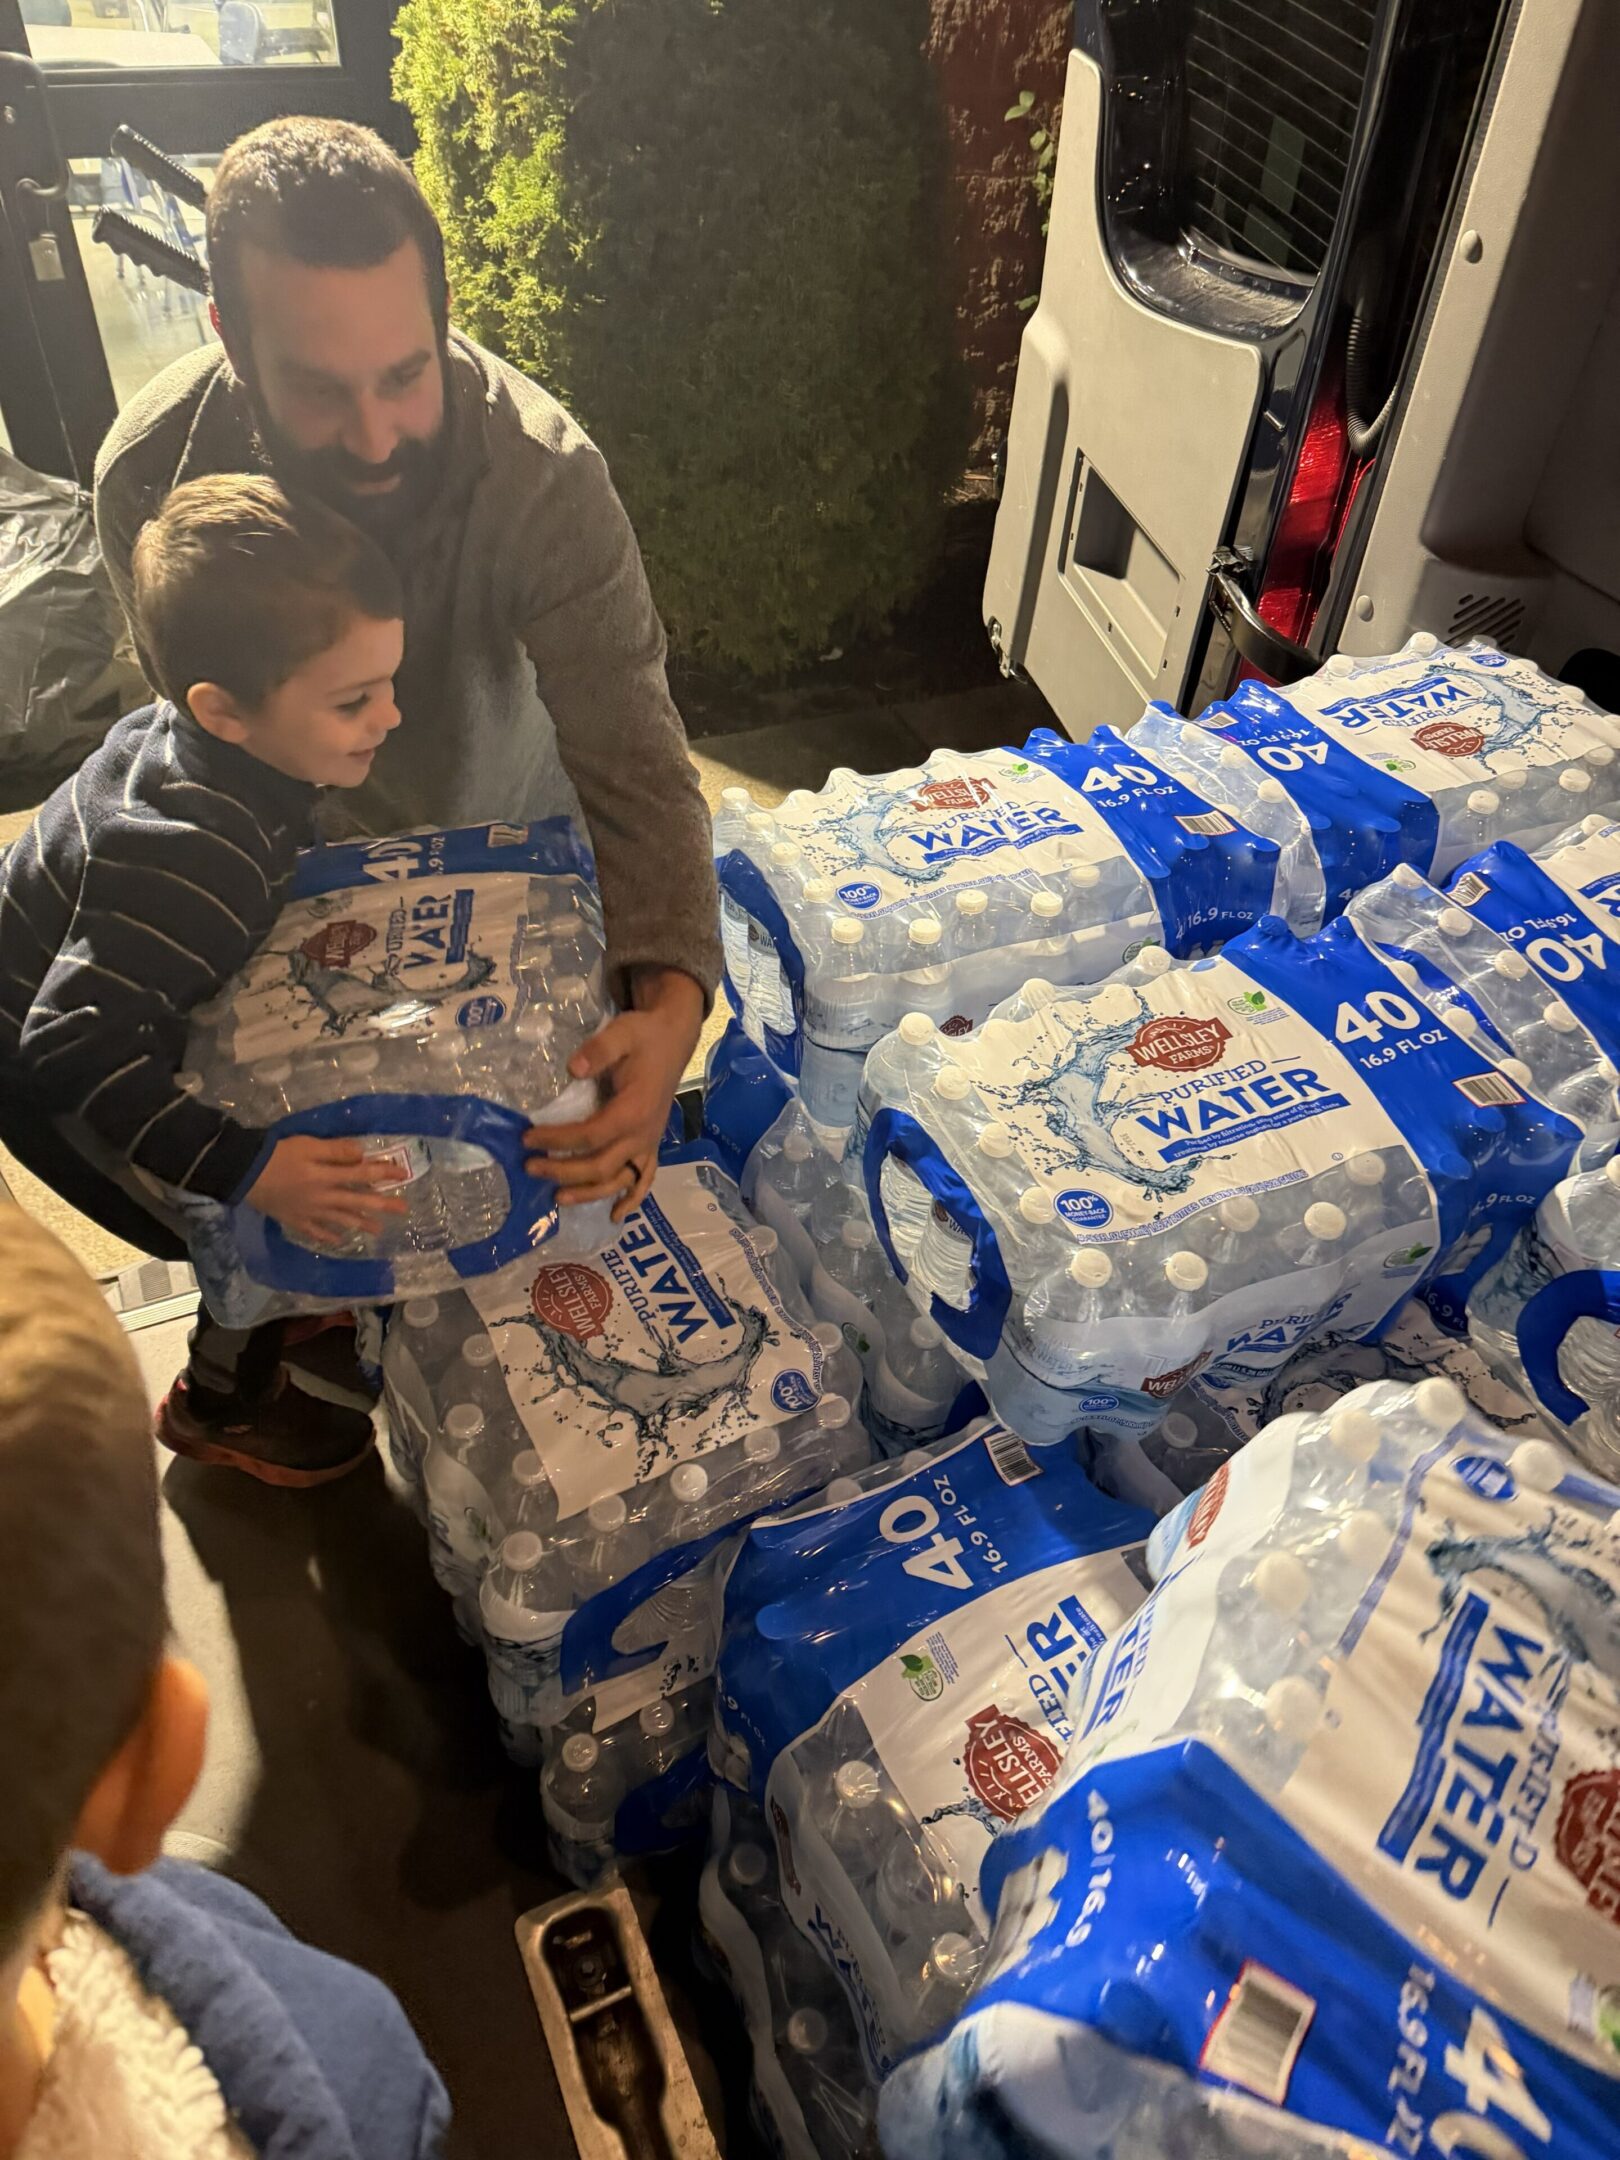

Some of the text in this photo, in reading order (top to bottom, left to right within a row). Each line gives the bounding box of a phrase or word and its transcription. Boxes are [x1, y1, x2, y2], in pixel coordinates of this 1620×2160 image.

[1333, 684, 1471, 729] WATER
[1082, 764, 1157, 792] 40
[1257, 741, 1329, 771] 40
[1097, 786, 1178, 809] 16.9 FL OZ
[1221, 911, 1240, 920] FL
[1240, 911, 1254, 920] OZ
[1500, 926, 1526, 942] OZ
[1525, 933, 1607, 982] 40
[1335, 991, 1421, 1044] 40
[1134, 1023, 1221, 1061] WELLSLEY
[1359, 1029, 1448, 1070] 16.9 FL OZ
[1135, 1068, 1330, 1140] WATER
[1158, 1059, 1267, 1104] PURIFIED
[1060, 1195, 1099, 1211] 100%
[547, 1266, 596, 1336] WELLSLEY
[573, 1272, 602, 1310] FARMS
[600, 1249, 657, 1324] PURIFIE
[879, 1495, 974, 1590] 40
[933, 1474, 1008, 1573] 16.9 FL OZ
[974, 1719, 1044, 1806] ELLSLEY
[1414, 1625, 1544, 1901] WATER
